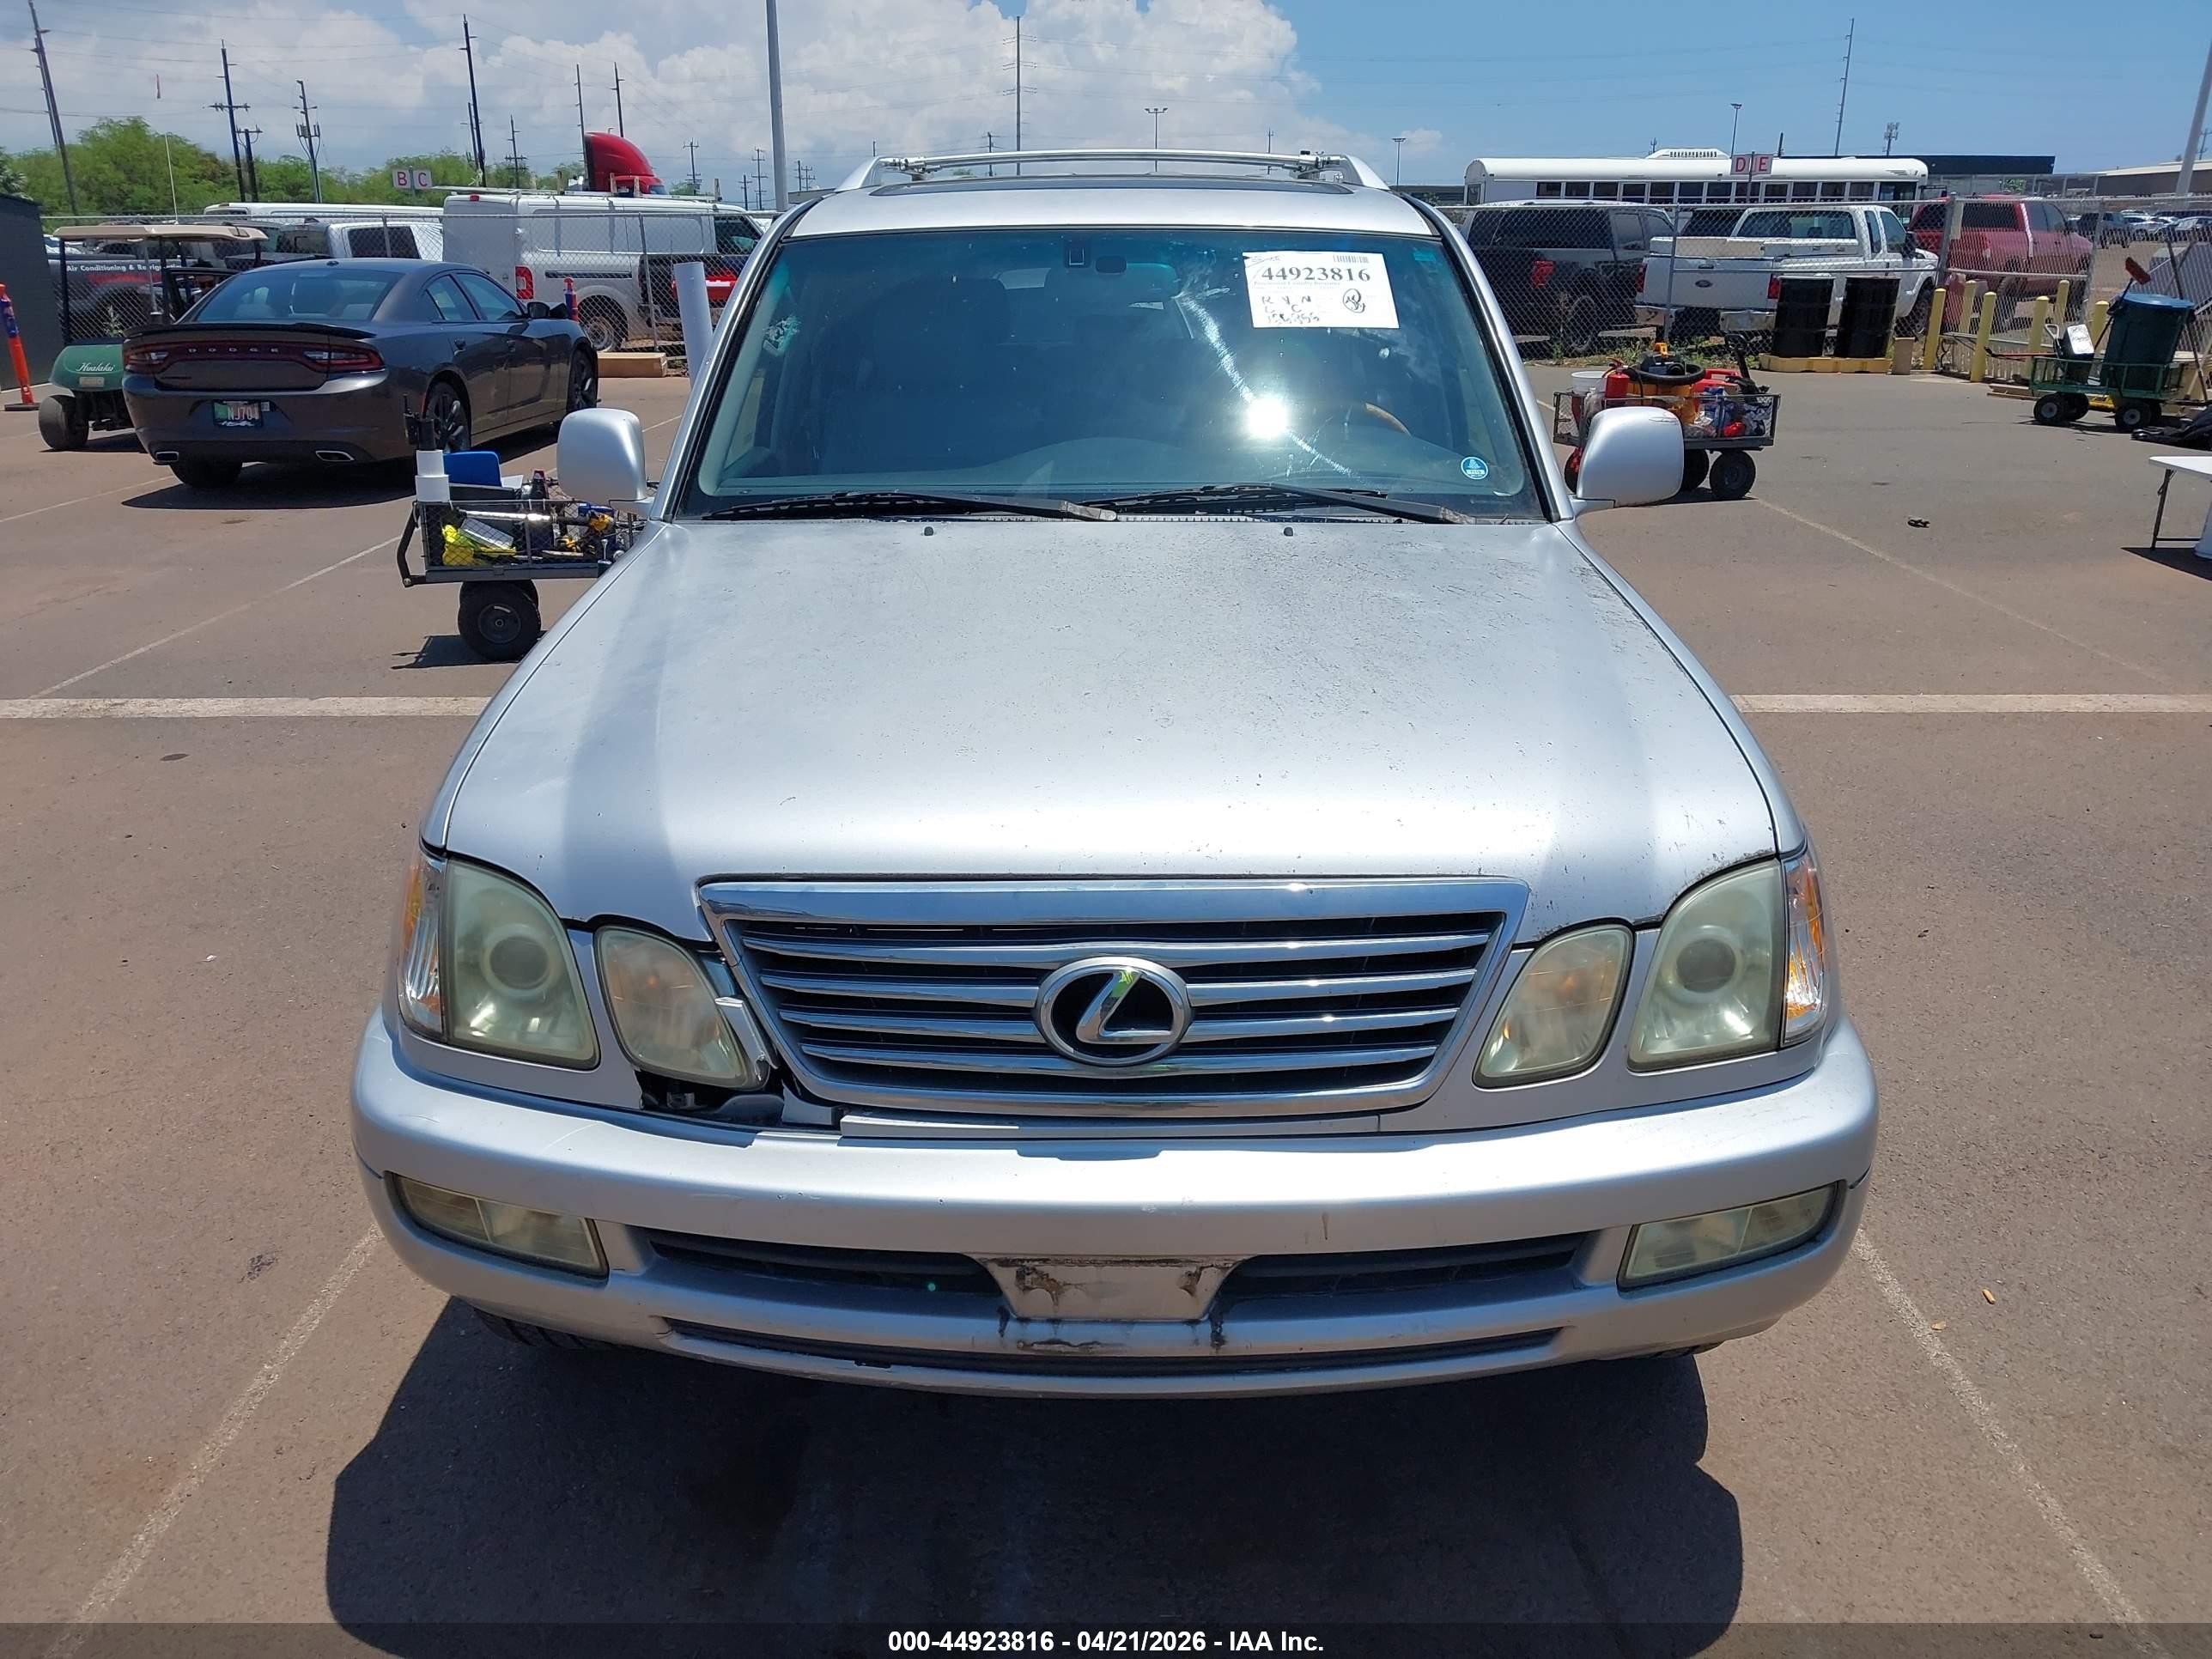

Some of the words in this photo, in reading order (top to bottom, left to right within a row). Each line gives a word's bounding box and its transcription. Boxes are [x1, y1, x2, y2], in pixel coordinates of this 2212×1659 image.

[1735, 157, 1746, 172] D
[1759, 156, 1769, 171] E
[397, 172, 407, 185] B
[418, 173, 428, 186] C
[1261, 266, 1370, 282] 44923816
